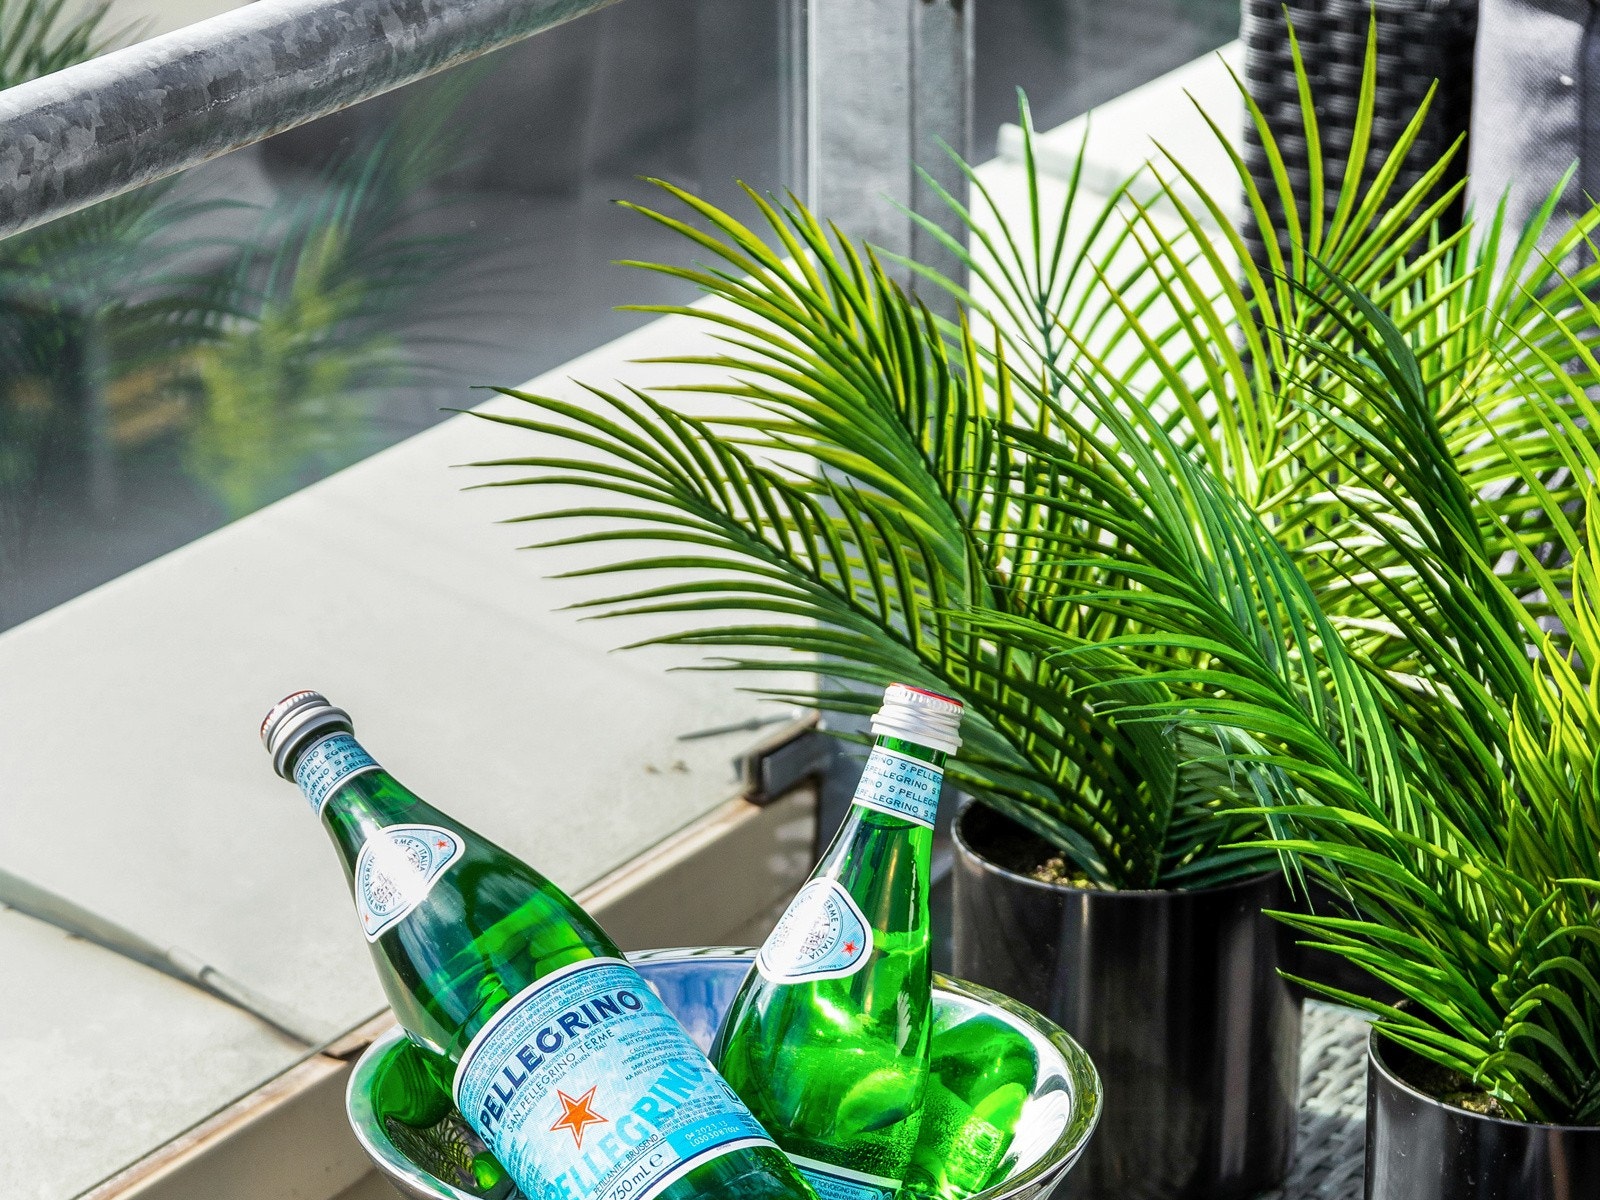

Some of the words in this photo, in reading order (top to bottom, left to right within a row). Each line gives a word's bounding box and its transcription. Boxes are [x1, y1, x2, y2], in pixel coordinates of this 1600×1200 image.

[808, 936, 836, 961] ITALIA
[480, 990, 644, 1150] S.PELLEGRINO
[507, 1111, 522, 1133] SAN
[519, 1053, 577, 1113] PELLEGRINO
[579, 1029, 615, 1053] TERME
[625, 1133, 659, 1161] BRUISEND
